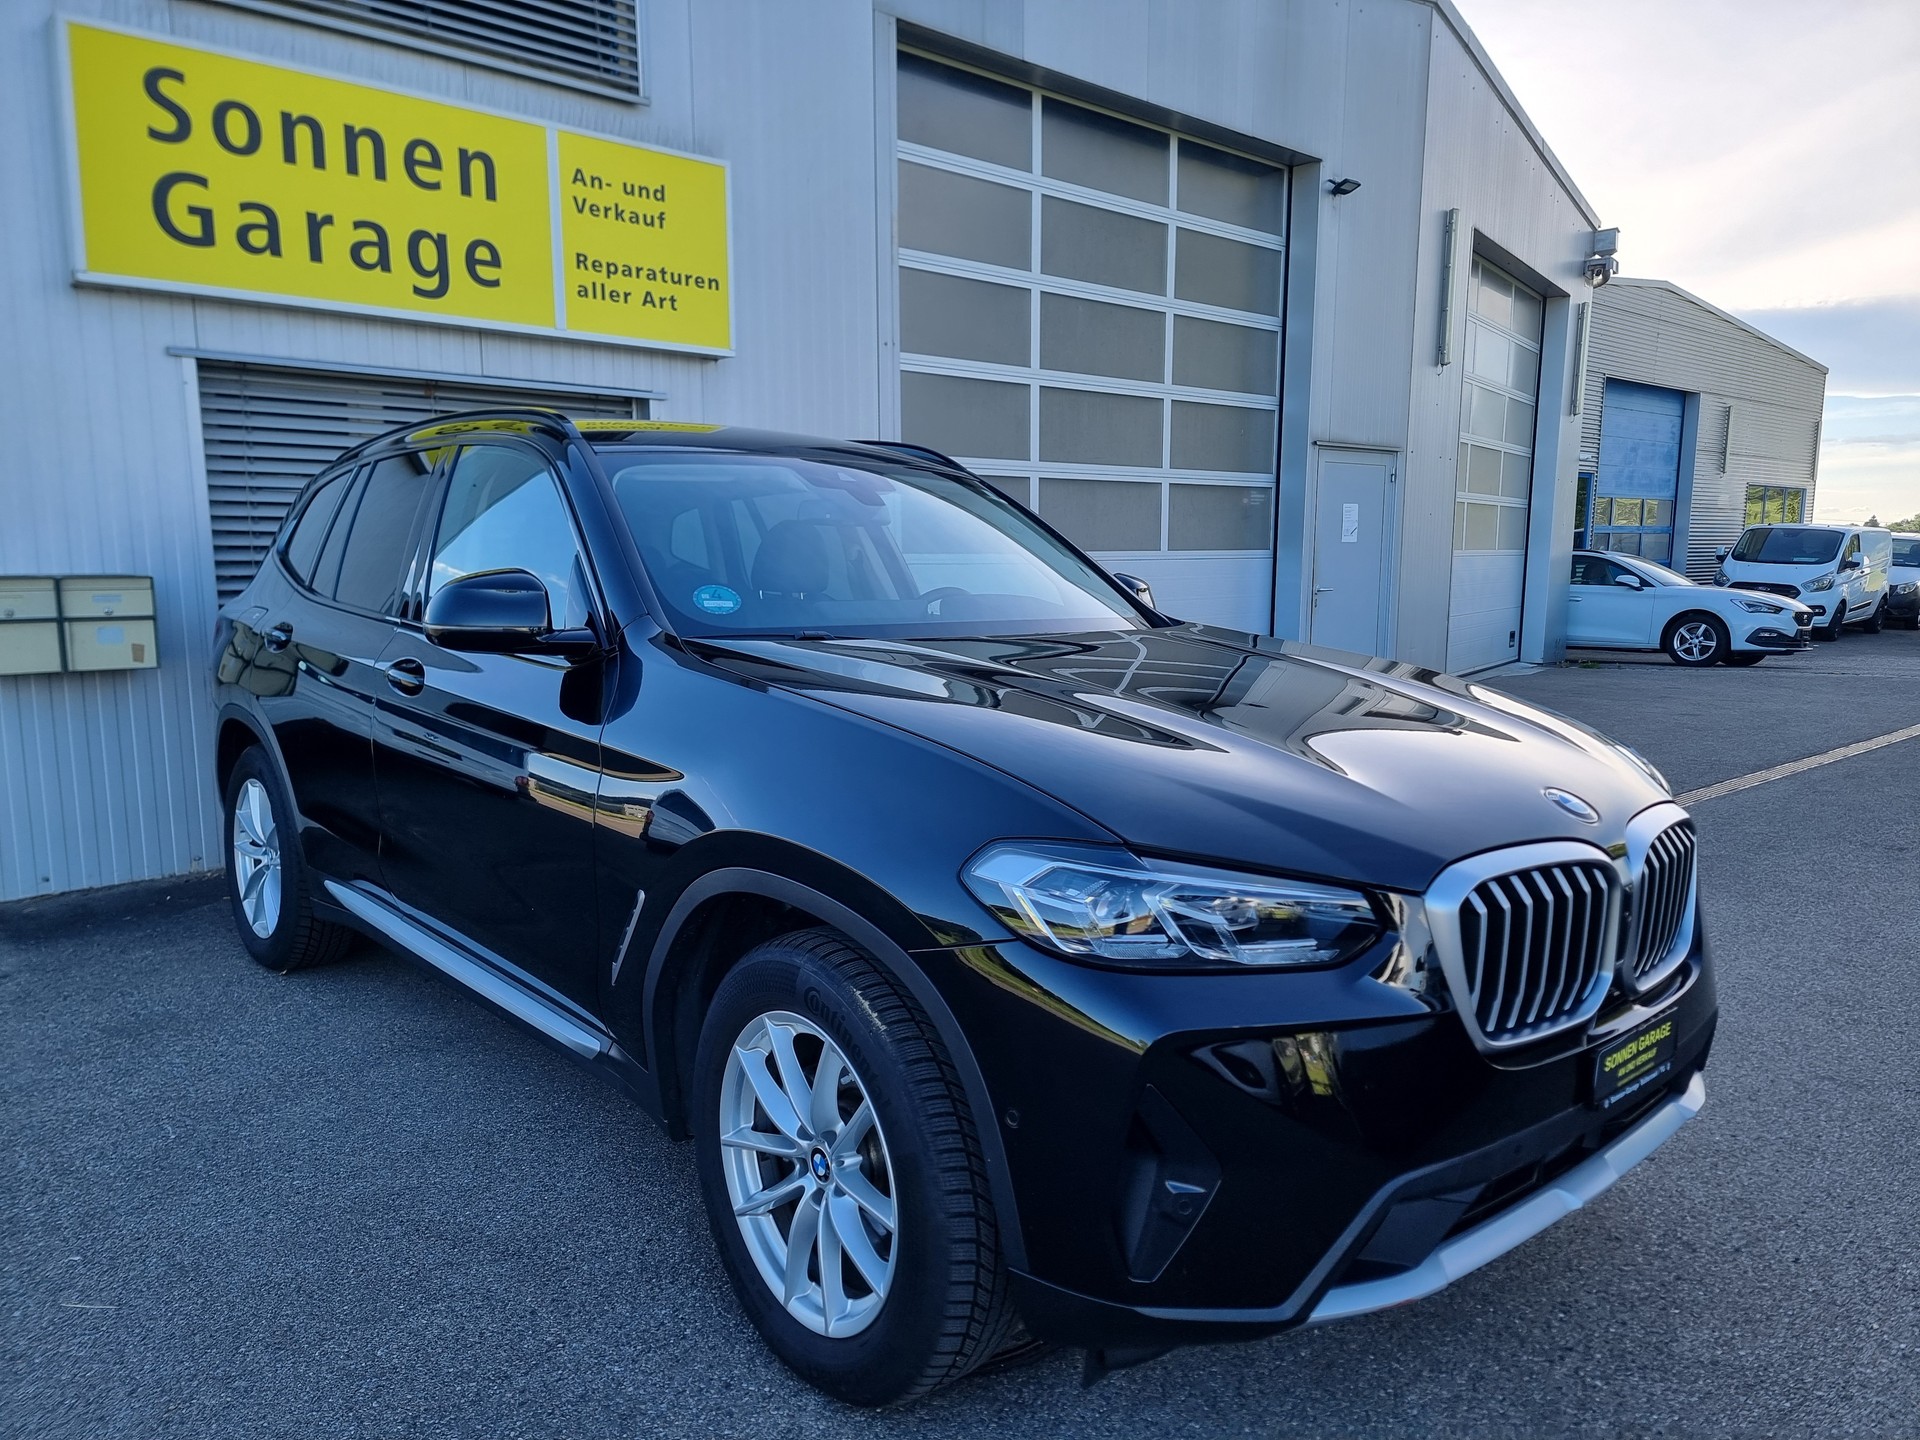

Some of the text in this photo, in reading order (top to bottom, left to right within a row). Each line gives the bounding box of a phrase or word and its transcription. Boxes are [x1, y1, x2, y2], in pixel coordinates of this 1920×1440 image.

[142, 66, 497, 202] Sonnen
[572, 167, 666, 203] An- und
[572, 195, 666, 230] Verkauf
[150, 171, 502, 300] Garage
[575, 252, 720, 291] Reparaturen
[577, 281, 678, 312] aller Art
[1603, 1022, 1672, 1072] SONNEN GARAGE
